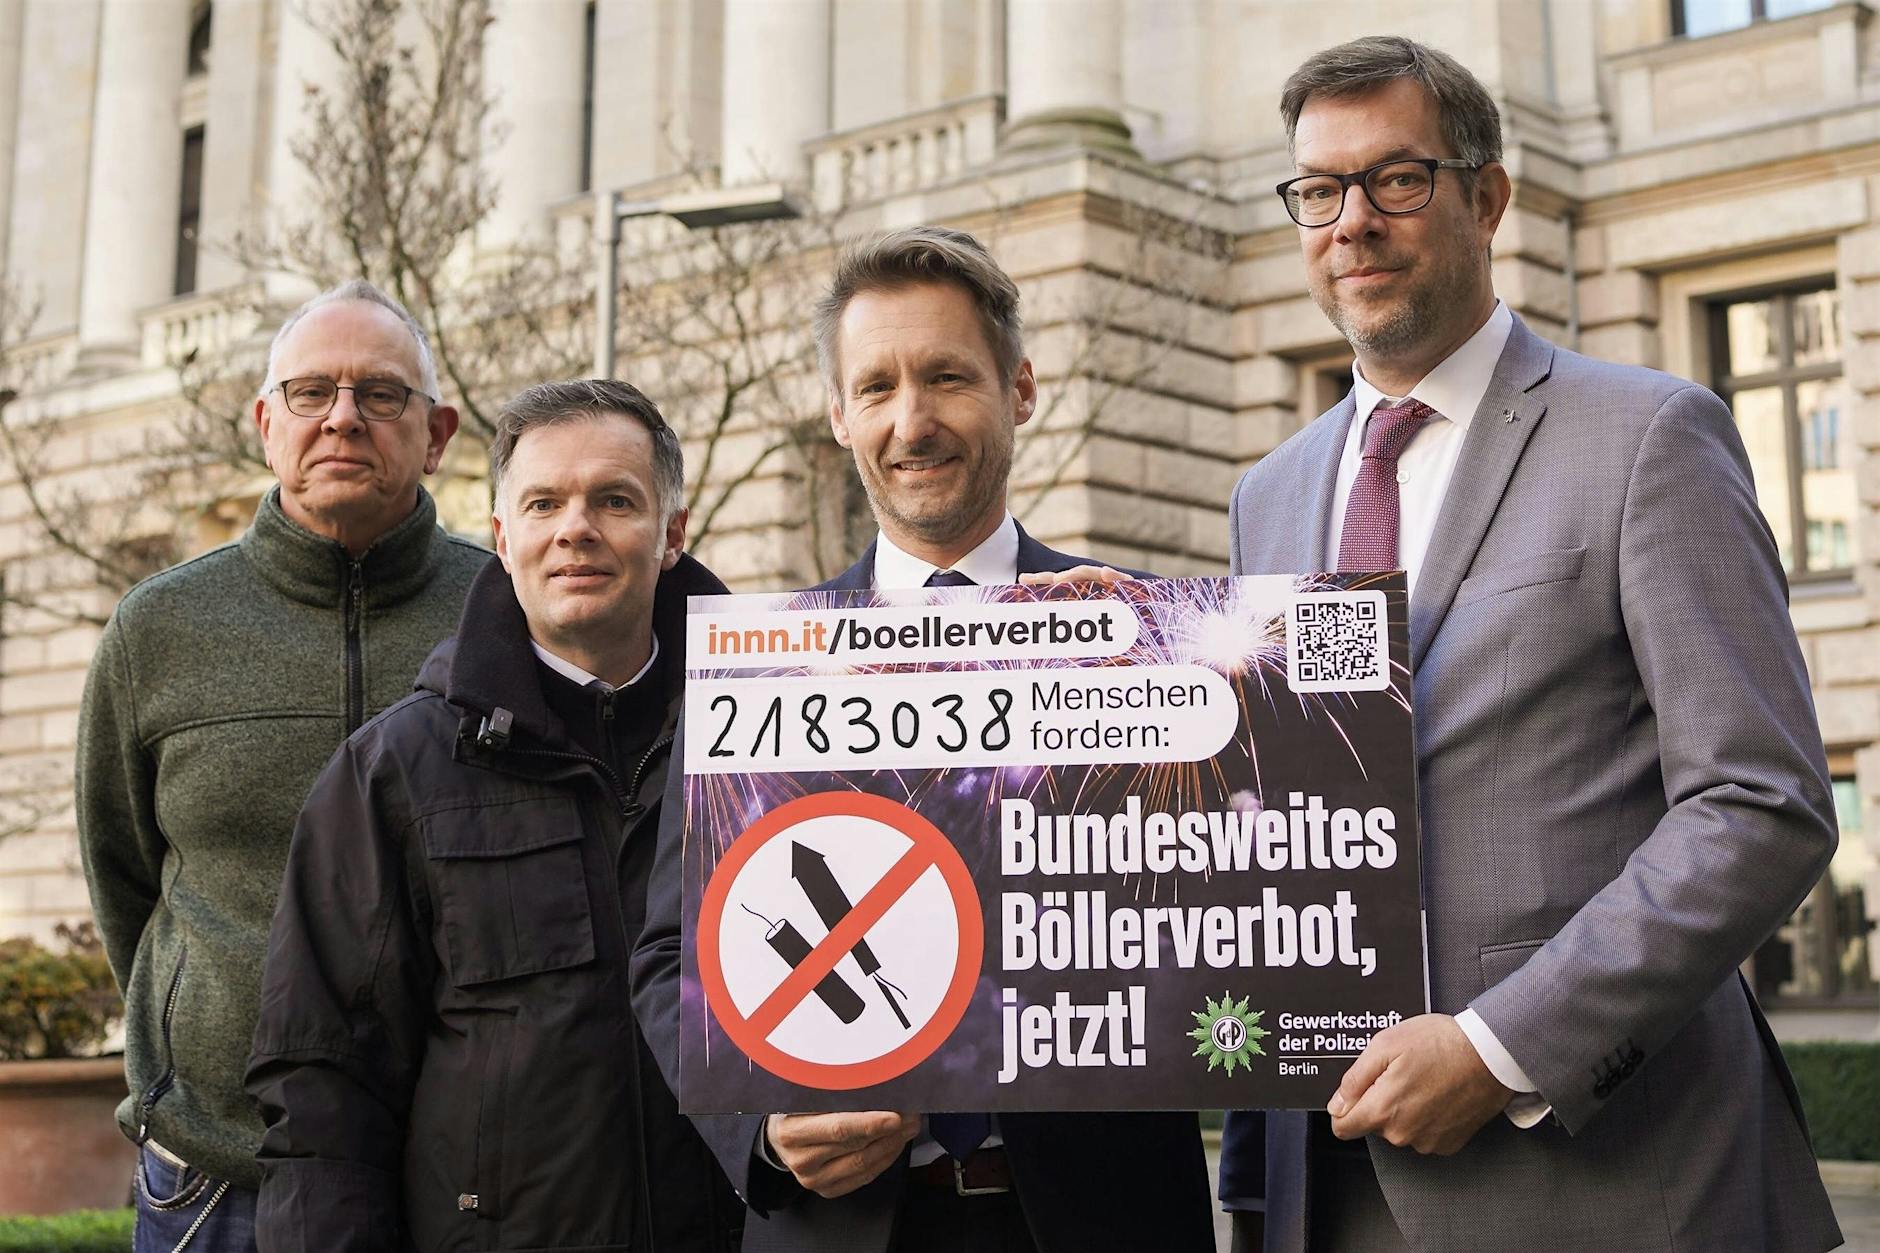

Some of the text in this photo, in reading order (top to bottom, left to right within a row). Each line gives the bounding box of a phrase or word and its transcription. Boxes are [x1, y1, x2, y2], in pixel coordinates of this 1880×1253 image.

[708, 612, 1113, 655] innn.it/boellerverbot
[1031, 680, 1208, 711] Menschen
[708, 689, 1013, 757] 2183038
[1031, 721, 1170, 750] fordern:
[1001, 792, 1397, 875] Bundesweites
[1002, 888, 1377, 976] Böllerverbot,
[998, 986, 1146, 1083] jetzt!
[1278, 1011, 1402, 1030] Gewerkschaft
[1278, 1033, 1371, 1051] der Polizei
[1278, 1062, 1319, 1075] Berlin
